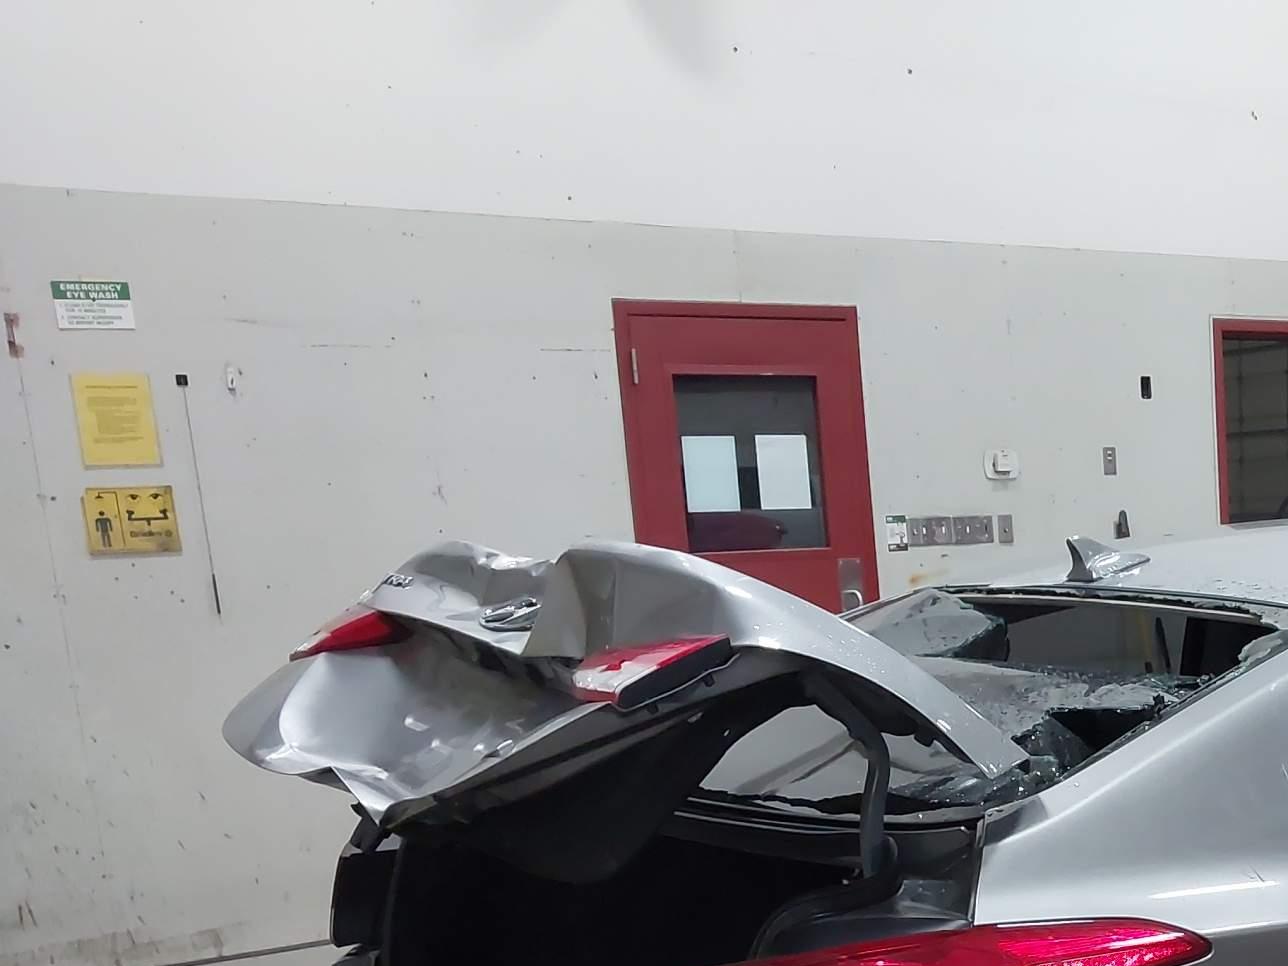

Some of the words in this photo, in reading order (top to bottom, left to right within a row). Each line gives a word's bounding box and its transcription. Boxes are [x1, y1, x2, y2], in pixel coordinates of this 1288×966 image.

[59, 283, 122, 291] EMERGENCY
[66, 291, 87, 299] EYE
[88, 291, 119, 299] WASH
